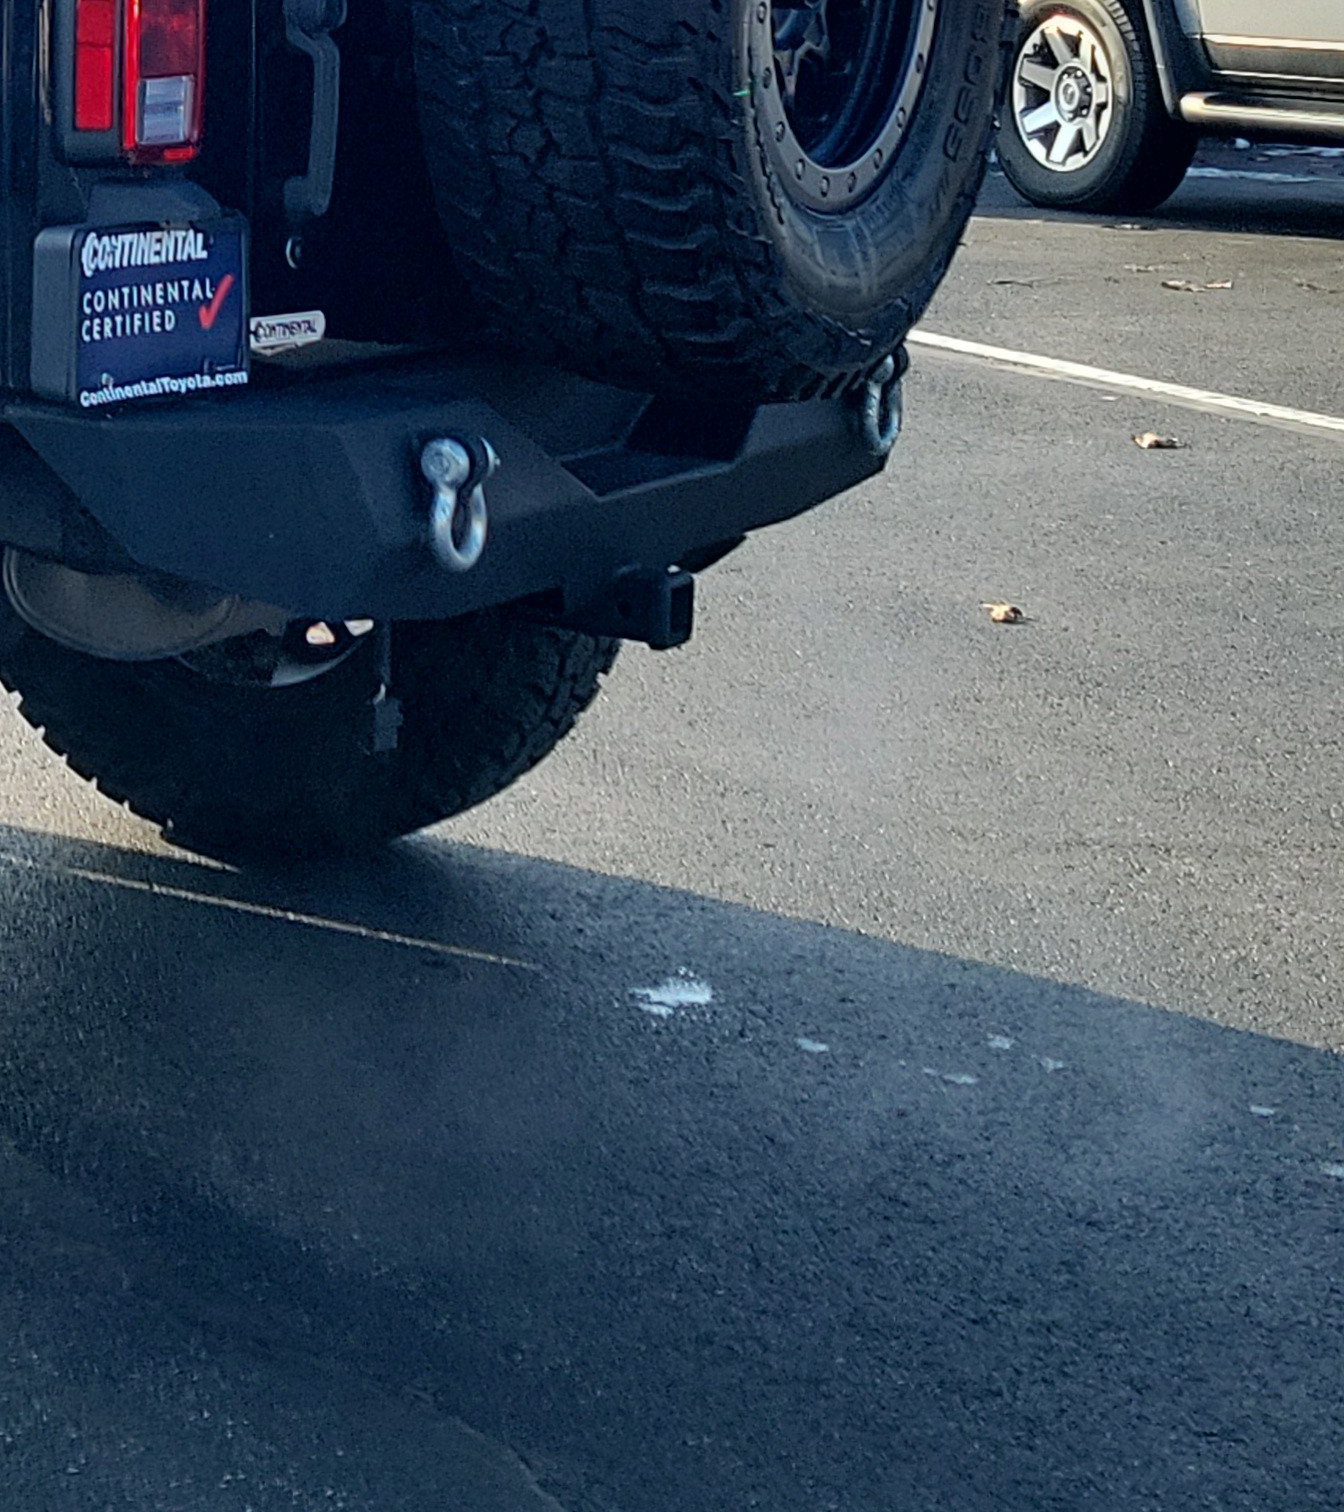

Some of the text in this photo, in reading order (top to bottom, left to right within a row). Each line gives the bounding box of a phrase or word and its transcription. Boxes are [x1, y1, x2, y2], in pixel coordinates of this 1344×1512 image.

[82, 229, 208, 278] CONTINENTAL
[82, 277, 214, 314] CONTINENTAL
[81, 311, 176, 342] CERTIFIED
[80, 369, 248, 408] ContinentalToyota.com
